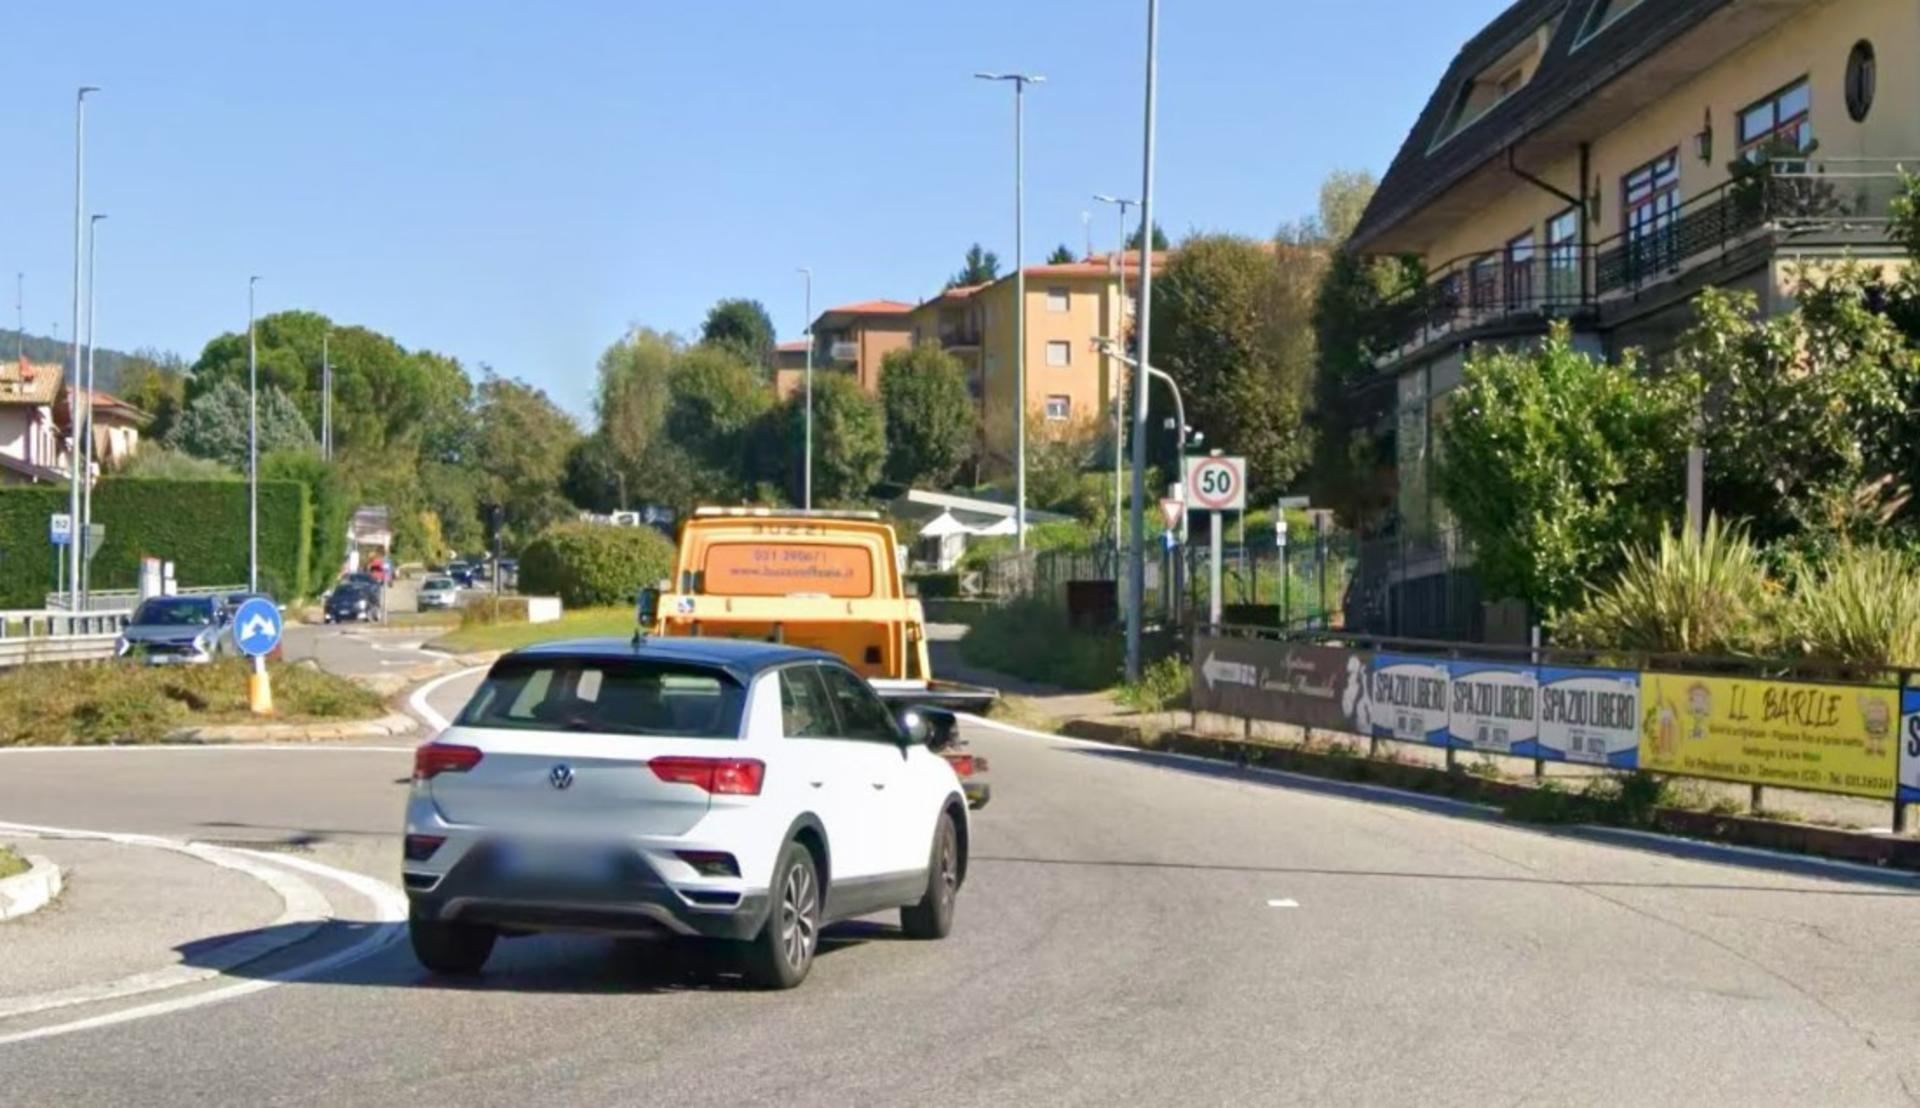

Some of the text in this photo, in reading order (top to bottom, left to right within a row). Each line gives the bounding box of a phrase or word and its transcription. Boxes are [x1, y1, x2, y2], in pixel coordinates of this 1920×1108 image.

[1202, 470, 1231, 494] 50
[1376, 673, 1409, 707] SPAZIO
[1410, 676, 1446, 712] LIBERO
[1453, 681, 1535, 721] SPAZIO LIBERO
[1542, 687, 1635, 731] SPAZIO LIBERO
[1728, 683, 1842, 729] IL BARILE
